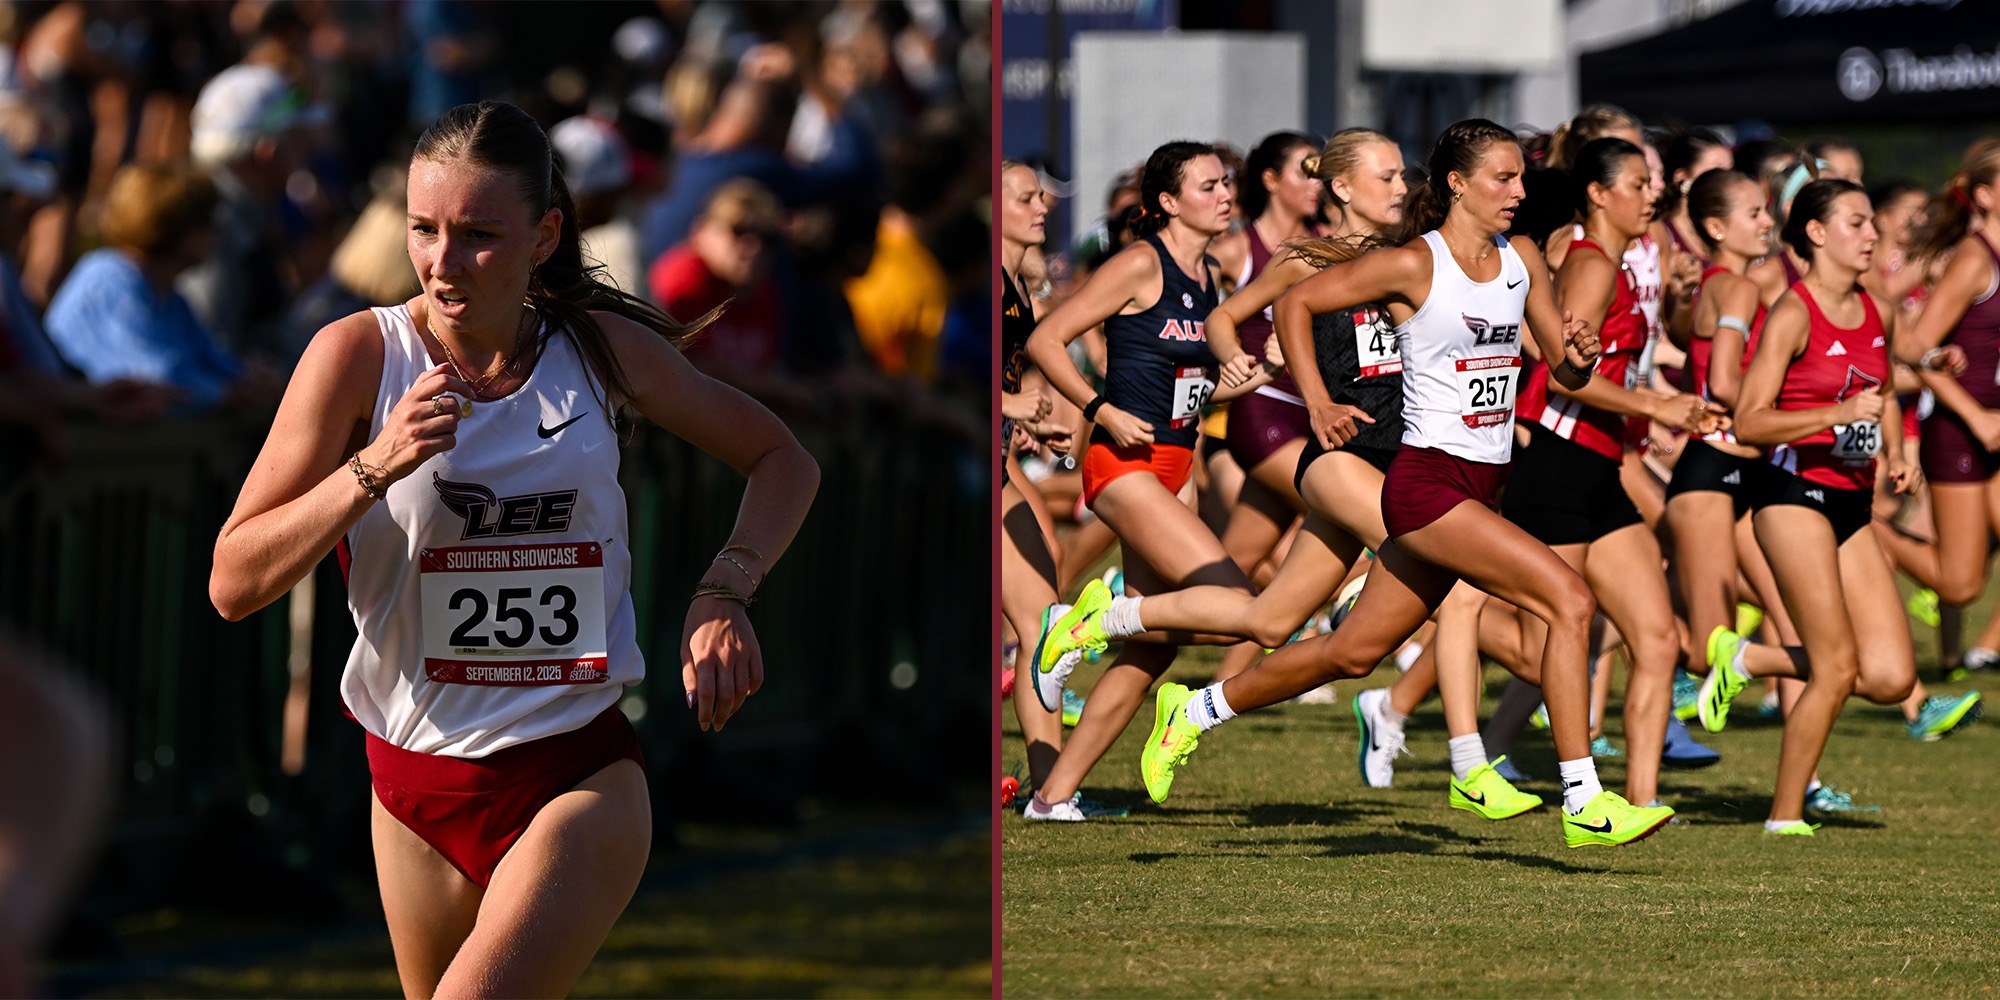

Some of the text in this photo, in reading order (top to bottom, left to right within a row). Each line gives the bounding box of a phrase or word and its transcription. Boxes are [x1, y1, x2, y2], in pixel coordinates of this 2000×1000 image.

[1473, 323, 1519, 347] LEE
[1468, 374, 1509, 408] 257
[1842, 424, 1876, 452] 285
[460, 489, 578, 541] LEE
[447, 547, 579, 569] SOUTHERN SHOWCASE
[448, 584, 580, 648] 253
[466, 666, 562, 682] SEPTEMBER 12, 2025
[569, 669, 597, 681] STATE
[573, 661, 594, 673] JAX
